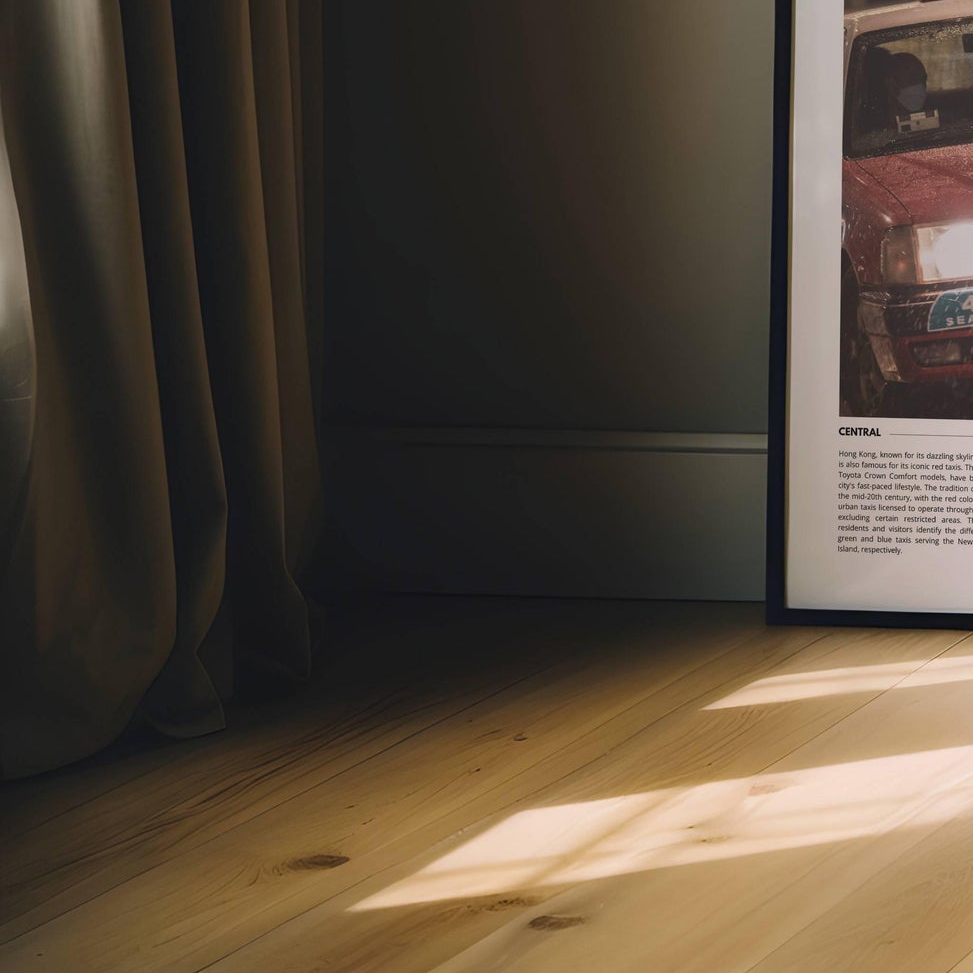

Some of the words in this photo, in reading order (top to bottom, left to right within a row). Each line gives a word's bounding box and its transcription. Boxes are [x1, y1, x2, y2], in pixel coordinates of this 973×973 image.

[838, 427, 881, 437] CENTRAL
[838, 450, 856, 460] Hong
[858, 450, 877, 460] Kong,
[879, 451, 902, 459] known
[904, 451, 914, 459] for
[916, 451, 924, 459] its
[926, 452, 954, 462] dazzling
[838, 460, 844, 468] is
[845, 460, 859, 469] also
[861, 461, 887, 469] famous
[888, 461, 898, 469] for
[900, 462, 908, 470] its
[910, 462, 929, 470] iconic
[931, 462, 943, 470] red
[945, 463, 962, 471] taxis.
[838, 471, 861, 481] Toyota
[864, 471, 886, 480] Crown
[888, 472, 917, 480] Comfort
[920, 473, 946, 482] models,
[949, 473, 966, 481] have
[837, 492, 849, 500] the
[851, 492, 882, 501] mid-20th
[884, 494, 911, 503] century,
[913, 494, 929, 502] with
[931, 494, 942, 502] the
[944, 494, 956, 502] red
[837, 502, 858, 511] urban
[860, 503, 876, 511] taxis
[878, 503, 906, 512] licensed
[917, 505, 944, 515] operate
[837, 513, 870, 524] excluding
[874, 514, 898, 522] certain
[903, 514, 936, 523] restricted
[837, 523, 868, 532] residents
[872, 524, 885, 532] and
[888, 525, 912, 533] visitors
[916, 525, 941, 536] identify
[944, 526, 956, 534] the
[837, 536, 857, 544] green
[860, 535, 873, 543] and
[877, 535, 892, 543] blue
[895, 535, 911, 544] taxis
[914, 536, 939, 546] serving
[942, 537, 954, 545] the
[957, 537, 973, 545] New
[837, 545, 859, 554] Island,
[860, 545, 902, 556] respectively.
